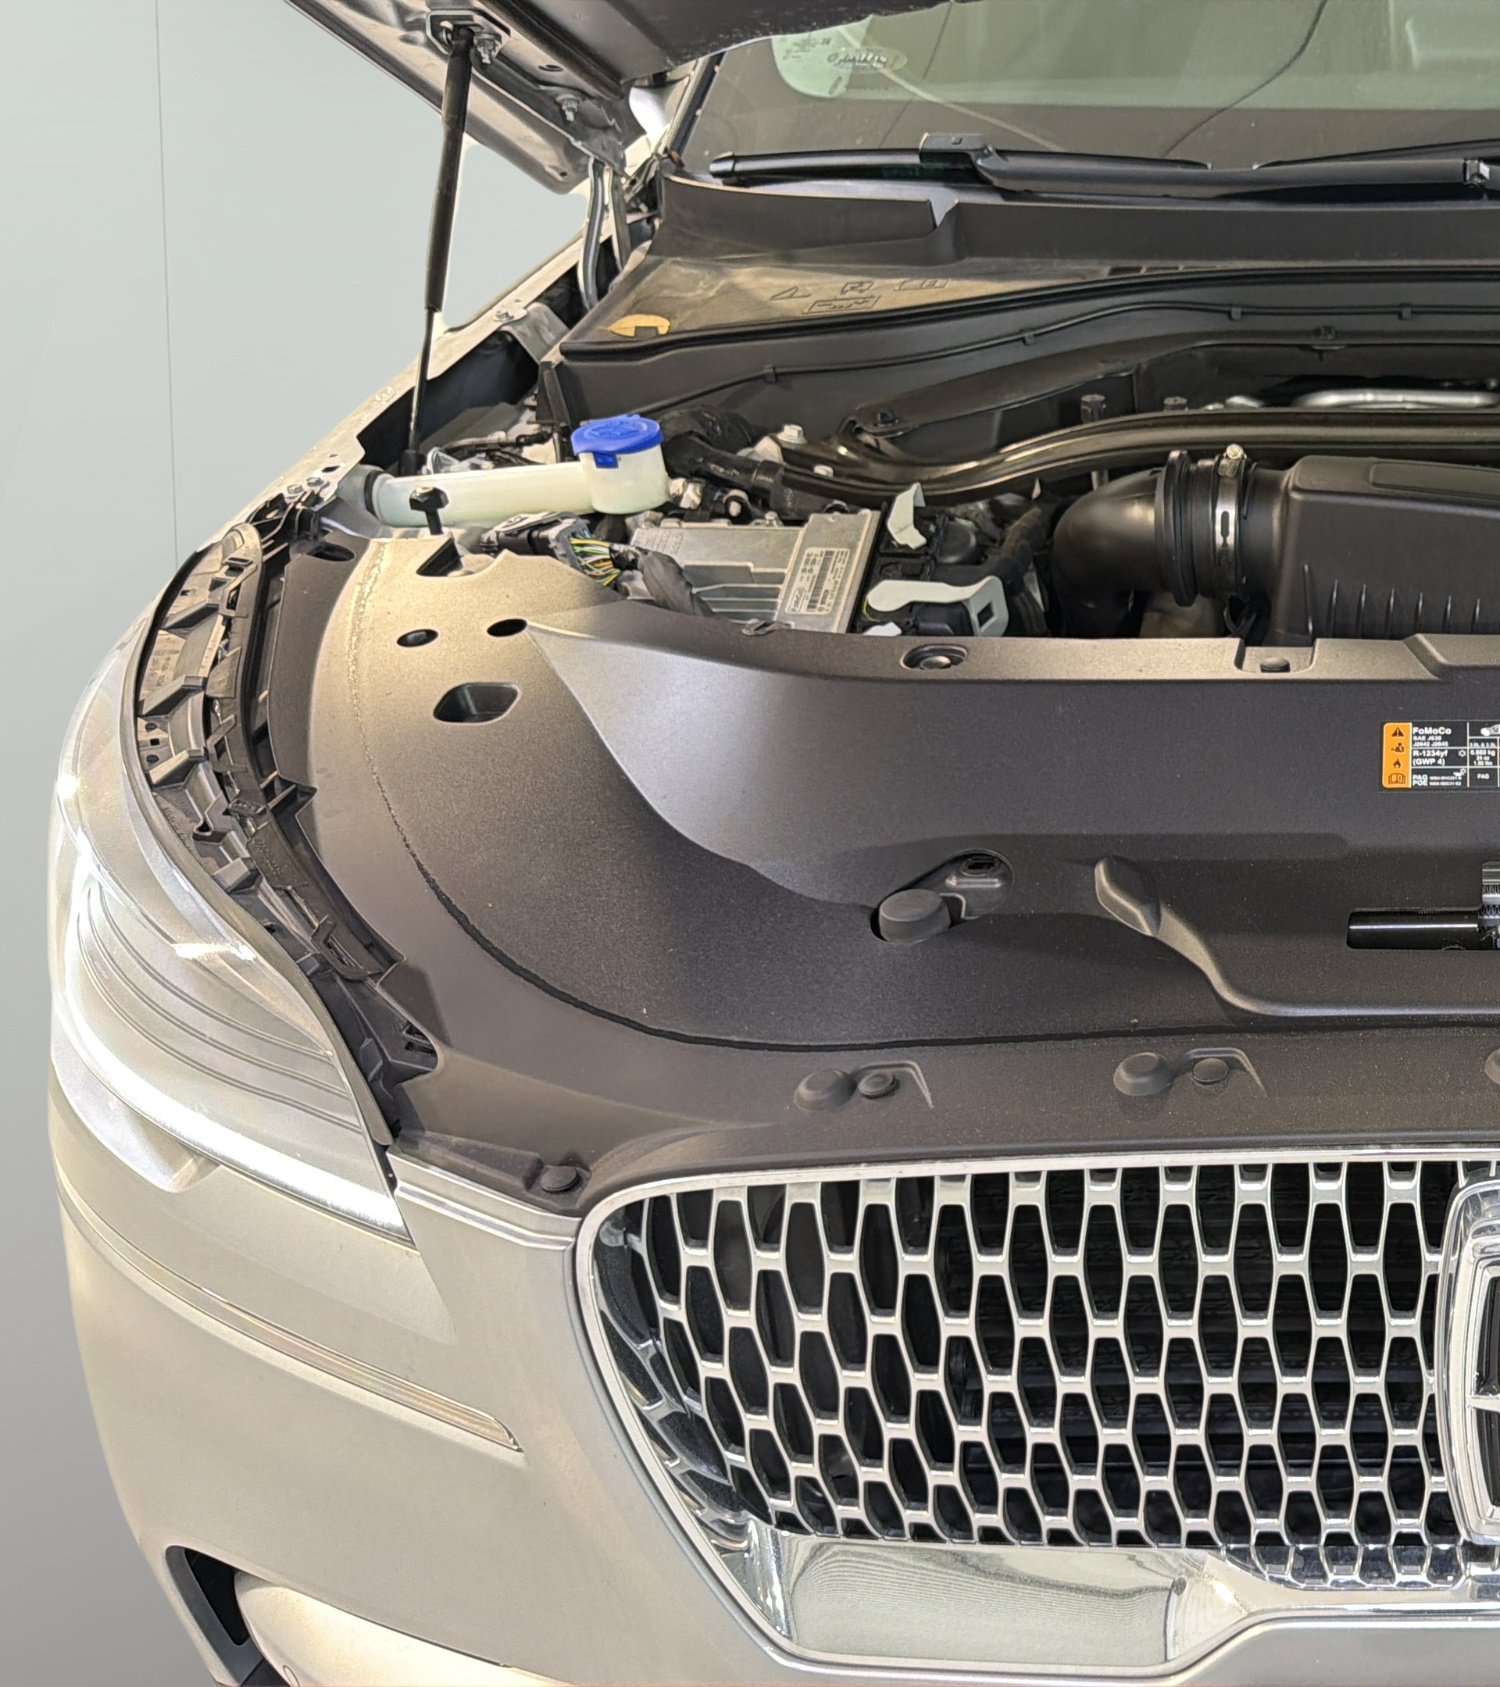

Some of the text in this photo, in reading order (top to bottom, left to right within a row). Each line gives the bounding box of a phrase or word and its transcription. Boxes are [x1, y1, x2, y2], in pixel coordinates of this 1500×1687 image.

[1413, 727, 1451, 735] FoMoCo
[1413, 750, 1448, 758] R-1234yf
[1413, 758, 1445, 766] (GWP 4)
